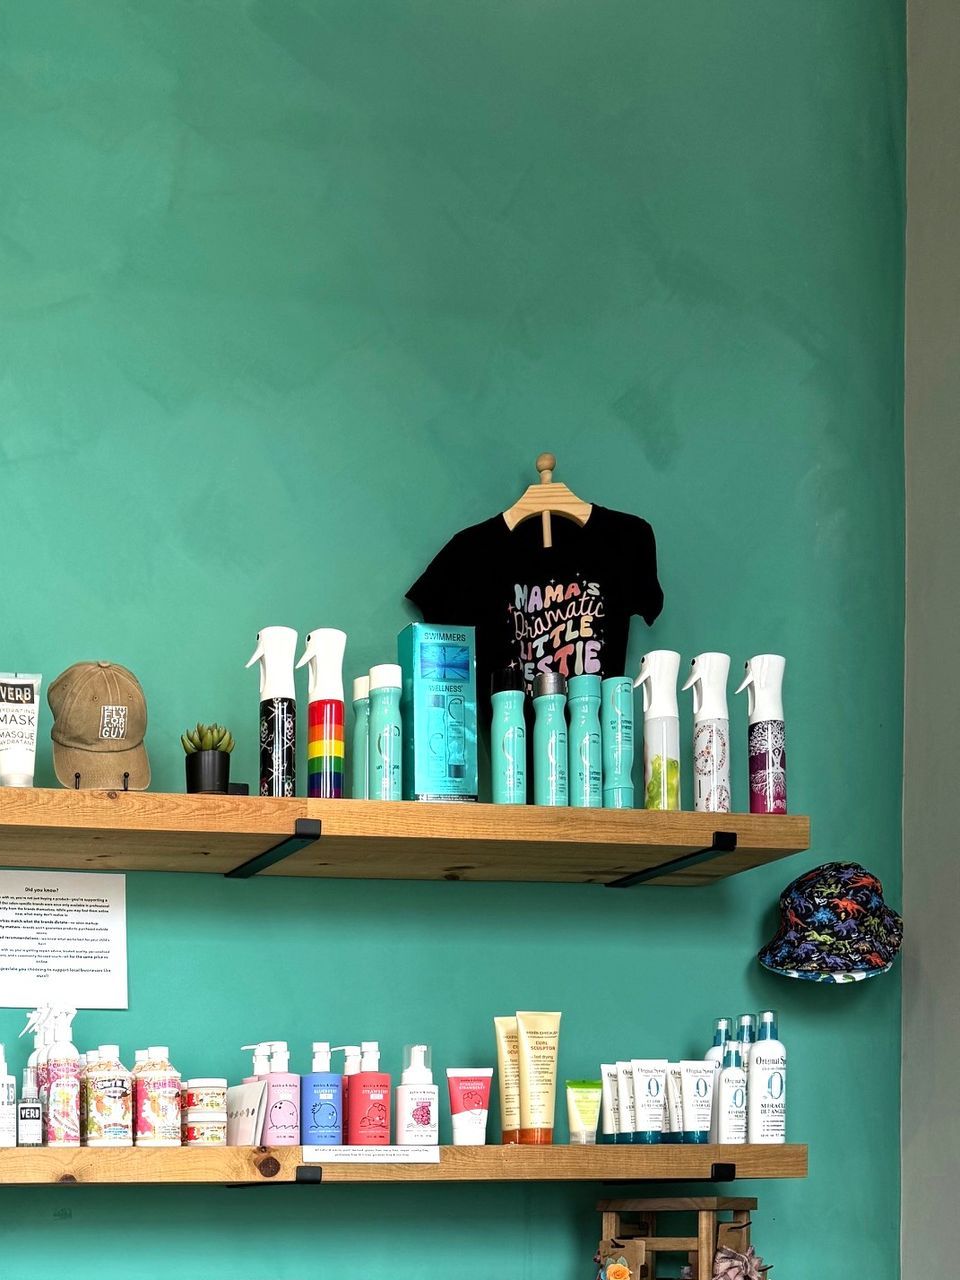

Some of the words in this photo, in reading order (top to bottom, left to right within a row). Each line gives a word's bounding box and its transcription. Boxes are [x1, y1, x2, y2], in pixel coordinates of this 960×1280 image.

[513, 580, 601, 614] MAMA'S
[513, 590, 606, 641] Dramatic
[424, 632, 466, 642] SWIMMERS
[520, 615, 594, 661] LITTLE
[0, 684, 32, 702] VERB
[429, 684, 464, 693] WELLNESS
[102, 727, 126, 738] GUY
[21, 1107, 40, 1119] VERB
